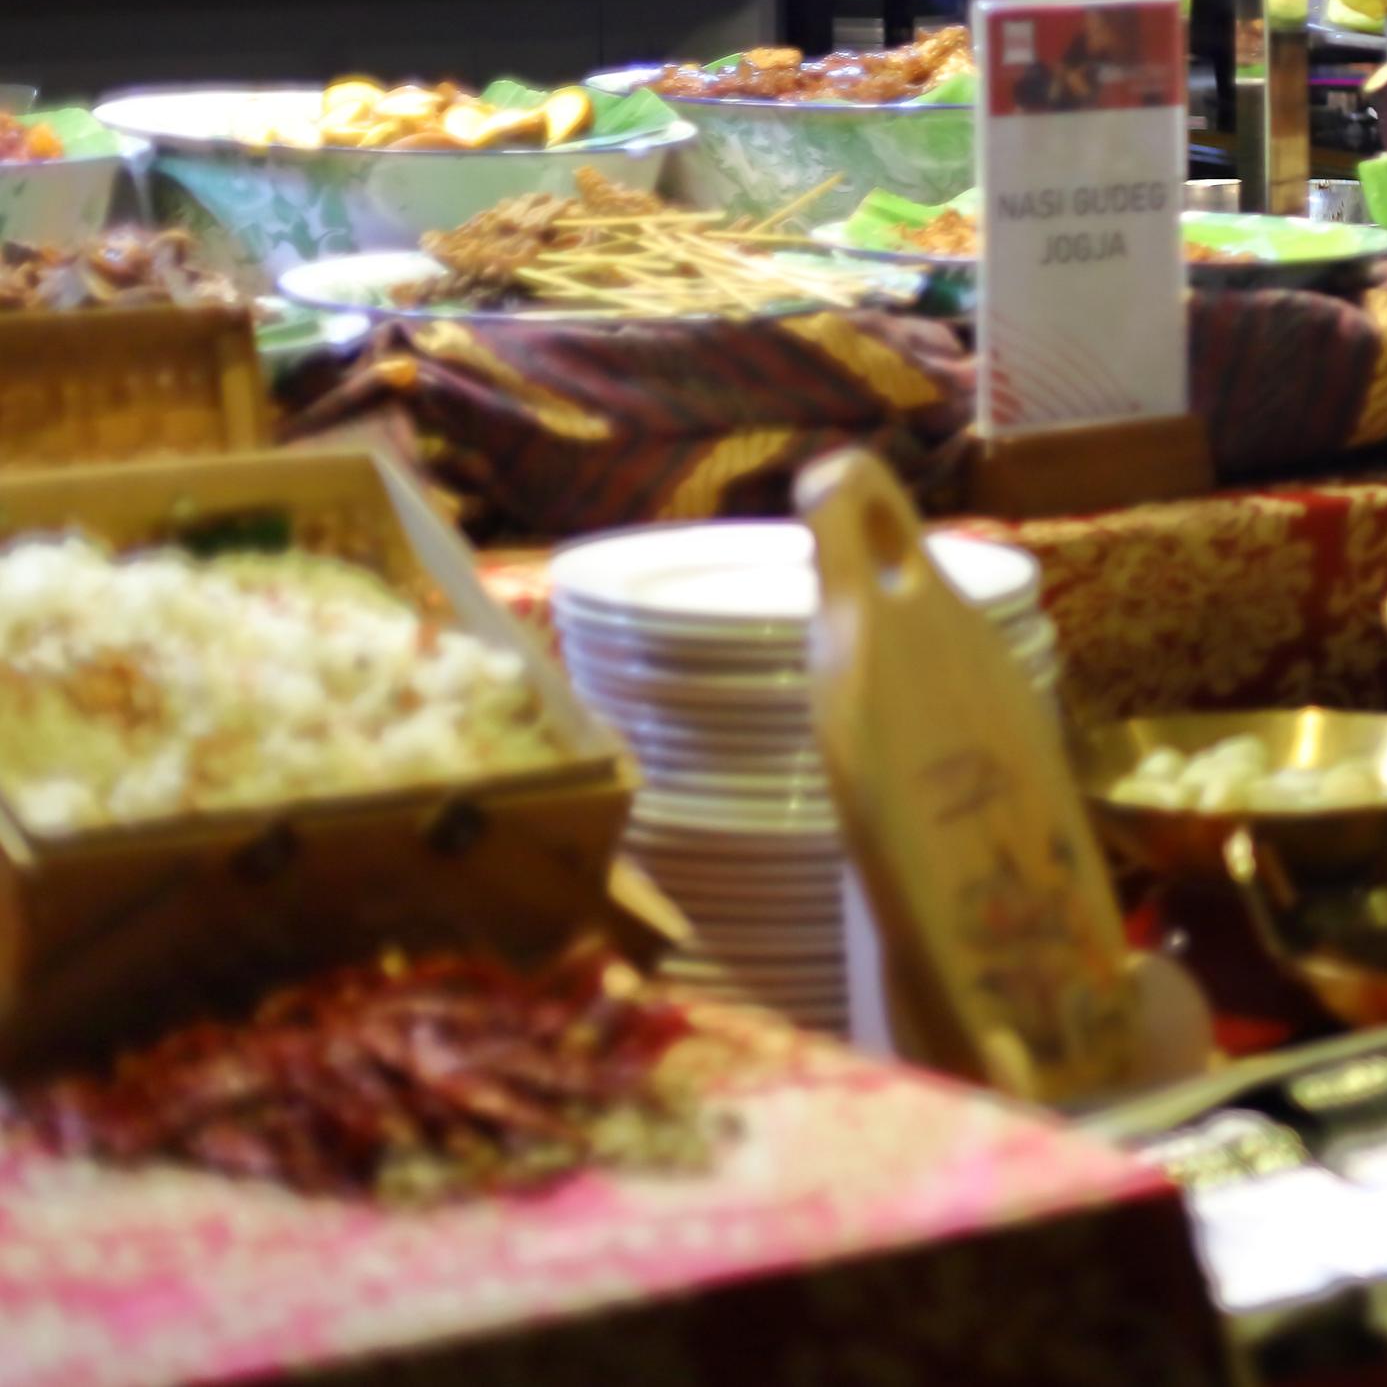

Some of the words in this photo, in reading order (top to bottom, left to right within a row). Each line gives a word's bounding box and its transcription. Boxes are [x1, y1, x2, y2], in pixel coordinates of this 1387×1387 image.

[998, 187, 1064, 222] NASI
[1073, 181, 1168, 217] GUDEG
[1039, 231, 1129, 267] JOGJA
